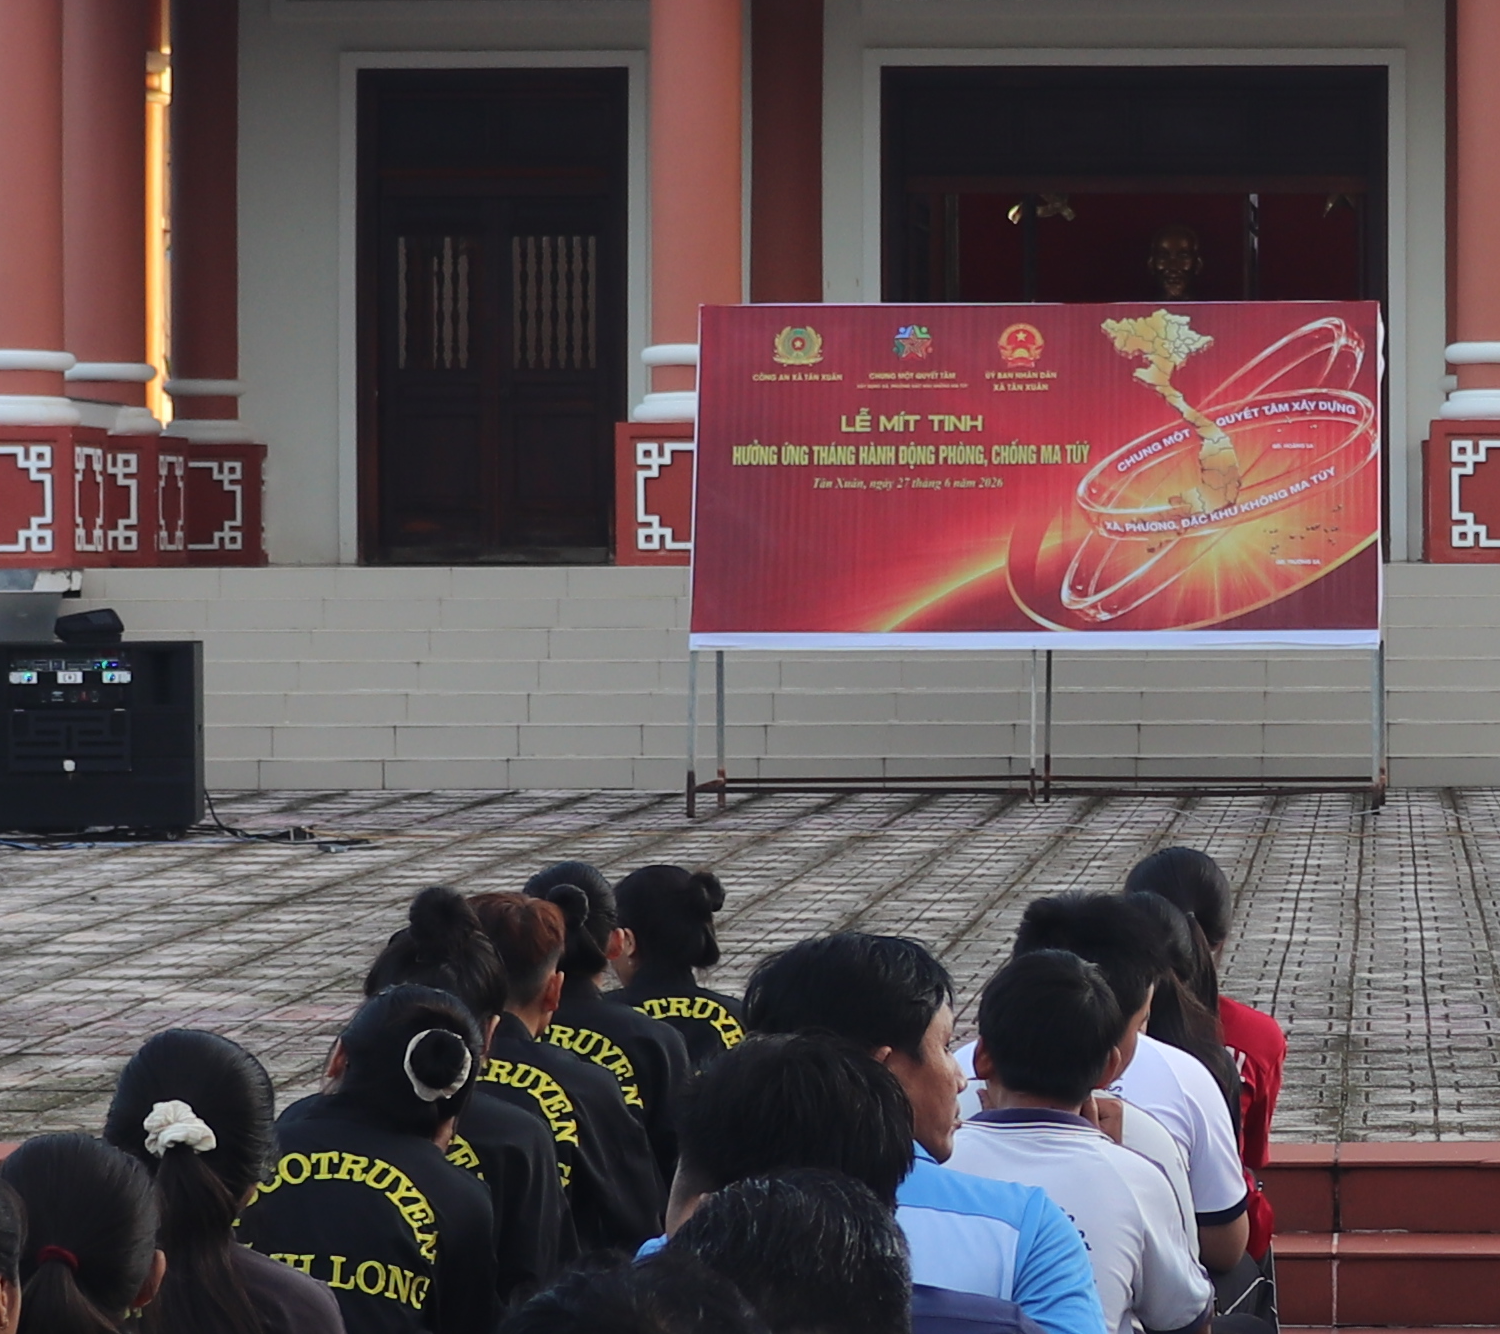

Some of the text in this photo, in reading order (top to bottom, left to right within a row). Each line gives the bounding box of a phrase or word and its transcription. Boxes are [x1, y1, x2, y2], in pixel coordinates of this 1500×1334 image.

[778, 373, 791, 382] AN
[868, 372, 897, 381] CHUNG
[997, 371, 1014, 380] BAN
[841, 407, 984, 433] LỄ MÍT TINH
[732, 439, 778, 466] HƯỞNG
[812, 441, 856, 466] THÁNG
[858, 441, 896, 466] HÀNH
[898, 441, 936, 470] ĐỘNG
[938, 441, 989, 467] PHÒNG,
[991, 438, 1038, 465] CHỐNG
[1040, 444, 1062, 465] MA
[1116, 441, 1163, 473] CHUNG
[813, 477, 834, 489] Tân
[835, 477, 867, 490] Xuân,
[897, 477, 911, 489] 27
[912, 477, 942, 491] tháng
[944, 477, 951, 488] 6
[978, 477, 1004, 488] 2026
[1209, 505, 1239, 523] KHU
[1239, 488, 1290, 514] KHÔNG
[1288, 480, 1312, 496] MA
[327, 1254, 431, 1310] LONG
